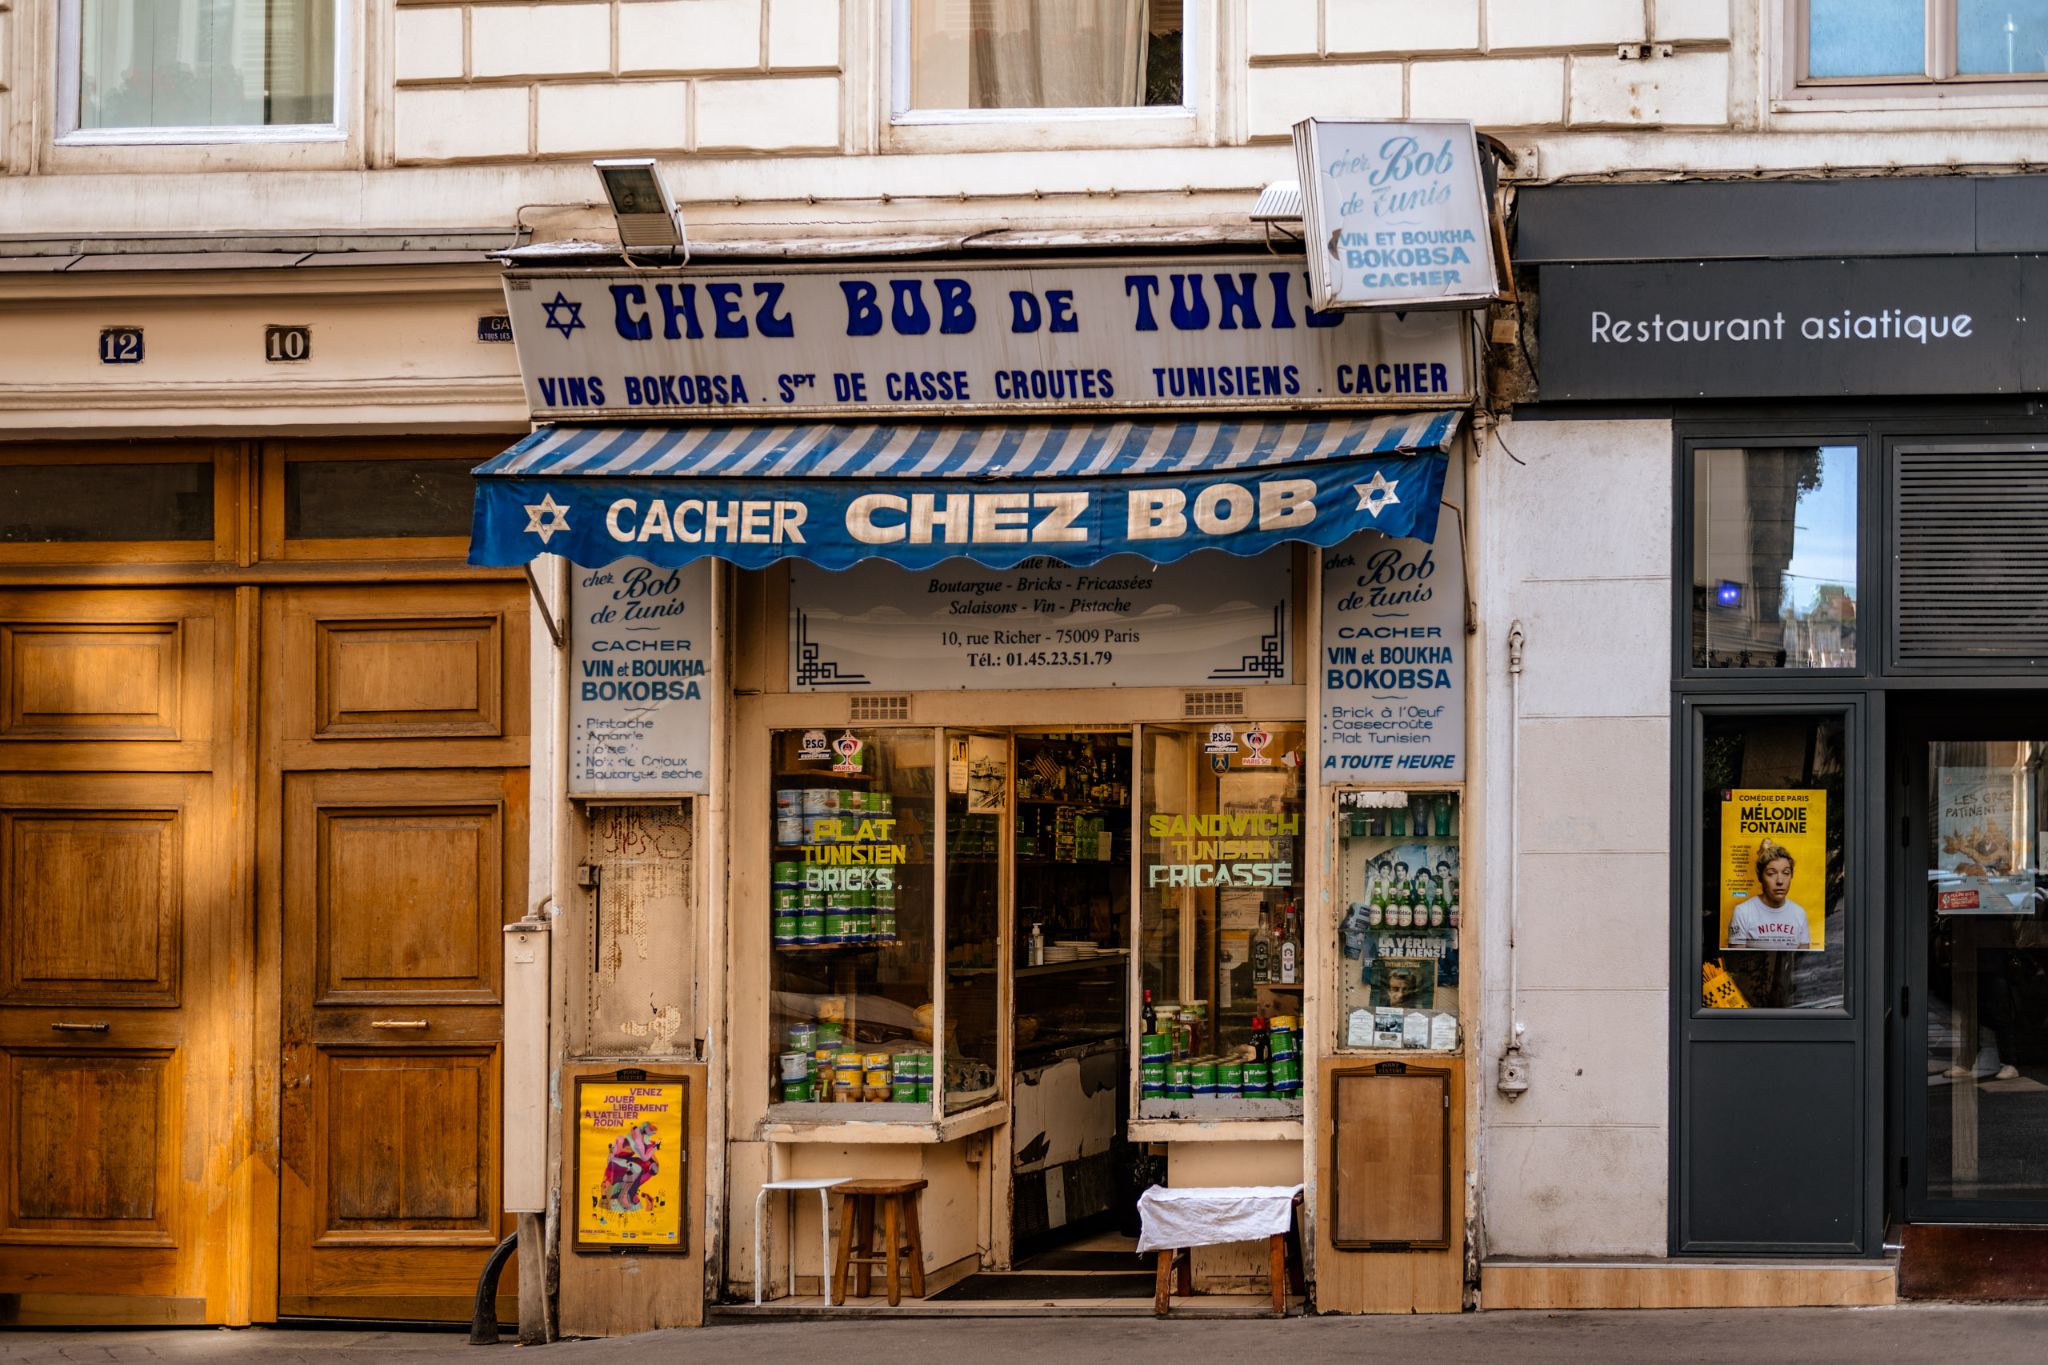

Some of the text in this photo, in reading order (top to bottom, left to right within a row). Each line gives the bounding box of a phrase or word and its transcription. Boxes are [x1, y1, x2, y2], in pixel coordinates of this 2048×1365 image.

[1368, 136, 1454, 187] Bob
[1340, 191, 1363, 217] de
[1340, 229, 1476, 247] VIN ET BOUKHA
[1347, 246, 1470, 269] BOKOBSA
[1362, 270, 1461, 288] CACHER
[609, 282, 794, 340] CHEZ
[839, 278, 977, 336] BOB
[1009, 290, 1079, 333] DE
[491, 318, 510, 330] GA
[1591, 309, 1973, 343] Restaurant asiatique
[105, 333, 137, 360] 12
[270, 331, 304, 358] 10
[538, 377, 605, 406] VINS
[625, 374, 748, 405] BOKOBSA
[834, 373, 867, 402] DE
[886, 371, 970, 401] CASSE
[994, 369, 1114, 399] CROUTES
[1153, 365, 1300, 397] TUNISIENS
[1337, 363, 1447, 394] CACHER
[605, 478, 1317, 544] CACHER CHEZ BOB
[1357, 549, 1435, 587] Bob
[583, 567, 681, 600] chez Bob
[927, 575, 1153, 596] Boutargue Bricks Fricassées
[948, 597, 1131, 615] Salaisons Vin Pistache
[1337, 583, 1432, 612] de Tunis
[591, 597, 685, 625] de Tunis
[941, 628, 1140, 649] 10, rue Richer 75009 Paris
[1338, 627, 1442, 639] CACHER
[591, 640, 691, 652] CACHER
[966, 650, 1113, 667] Tél.: 01.45.23.51.79
[1328, 647, 1453, 664] VIN et BOUKHA
[582, 659, 705, 677] VIN et BOUKHA
[1327, 669, 1452, 690] BOKOBSA
[581, 680, 701, 701] BOKOBSA
[1332, 706, 1374, 718] Brick
[1381, 706, 1392, 718] à
[586, 717, 654, 729] Pistache
[1332, 719, 1433, 730] Cassecroûte
[1332, 732, 1431, 743] Plat Tunisien
[1324, 754, 1455, 769] A TOUTE HEURE
[661, 768, 703, 779] sèche
[1738, 793, 1774, 802] COMÉDIE
[1954, 793, 1978, 805] LES
[1740, 803, 1807, 820] MÉLODIE
[813, 819, 896, 842] PLAT
[1149, 813, 1299, 837] SANDWICH
[1740, 821, 1807, 833] FONTAINE
[801, 844, 906, 865] TUNISIEN
[1757, 923, 1795, 935] NICKEL
[1378, 937, 1394, 948] LA
[1378, 947, 1389, 957] SI
[1390, 947, 1403, 957] JE
[603, 1095, 635, 1104] JOUER
[629, 1088, 663, 1096] VENEZ
[613, 1103, 668, 1112] LIBREMENT
[593, 1118, 624, 1127] RODIN
